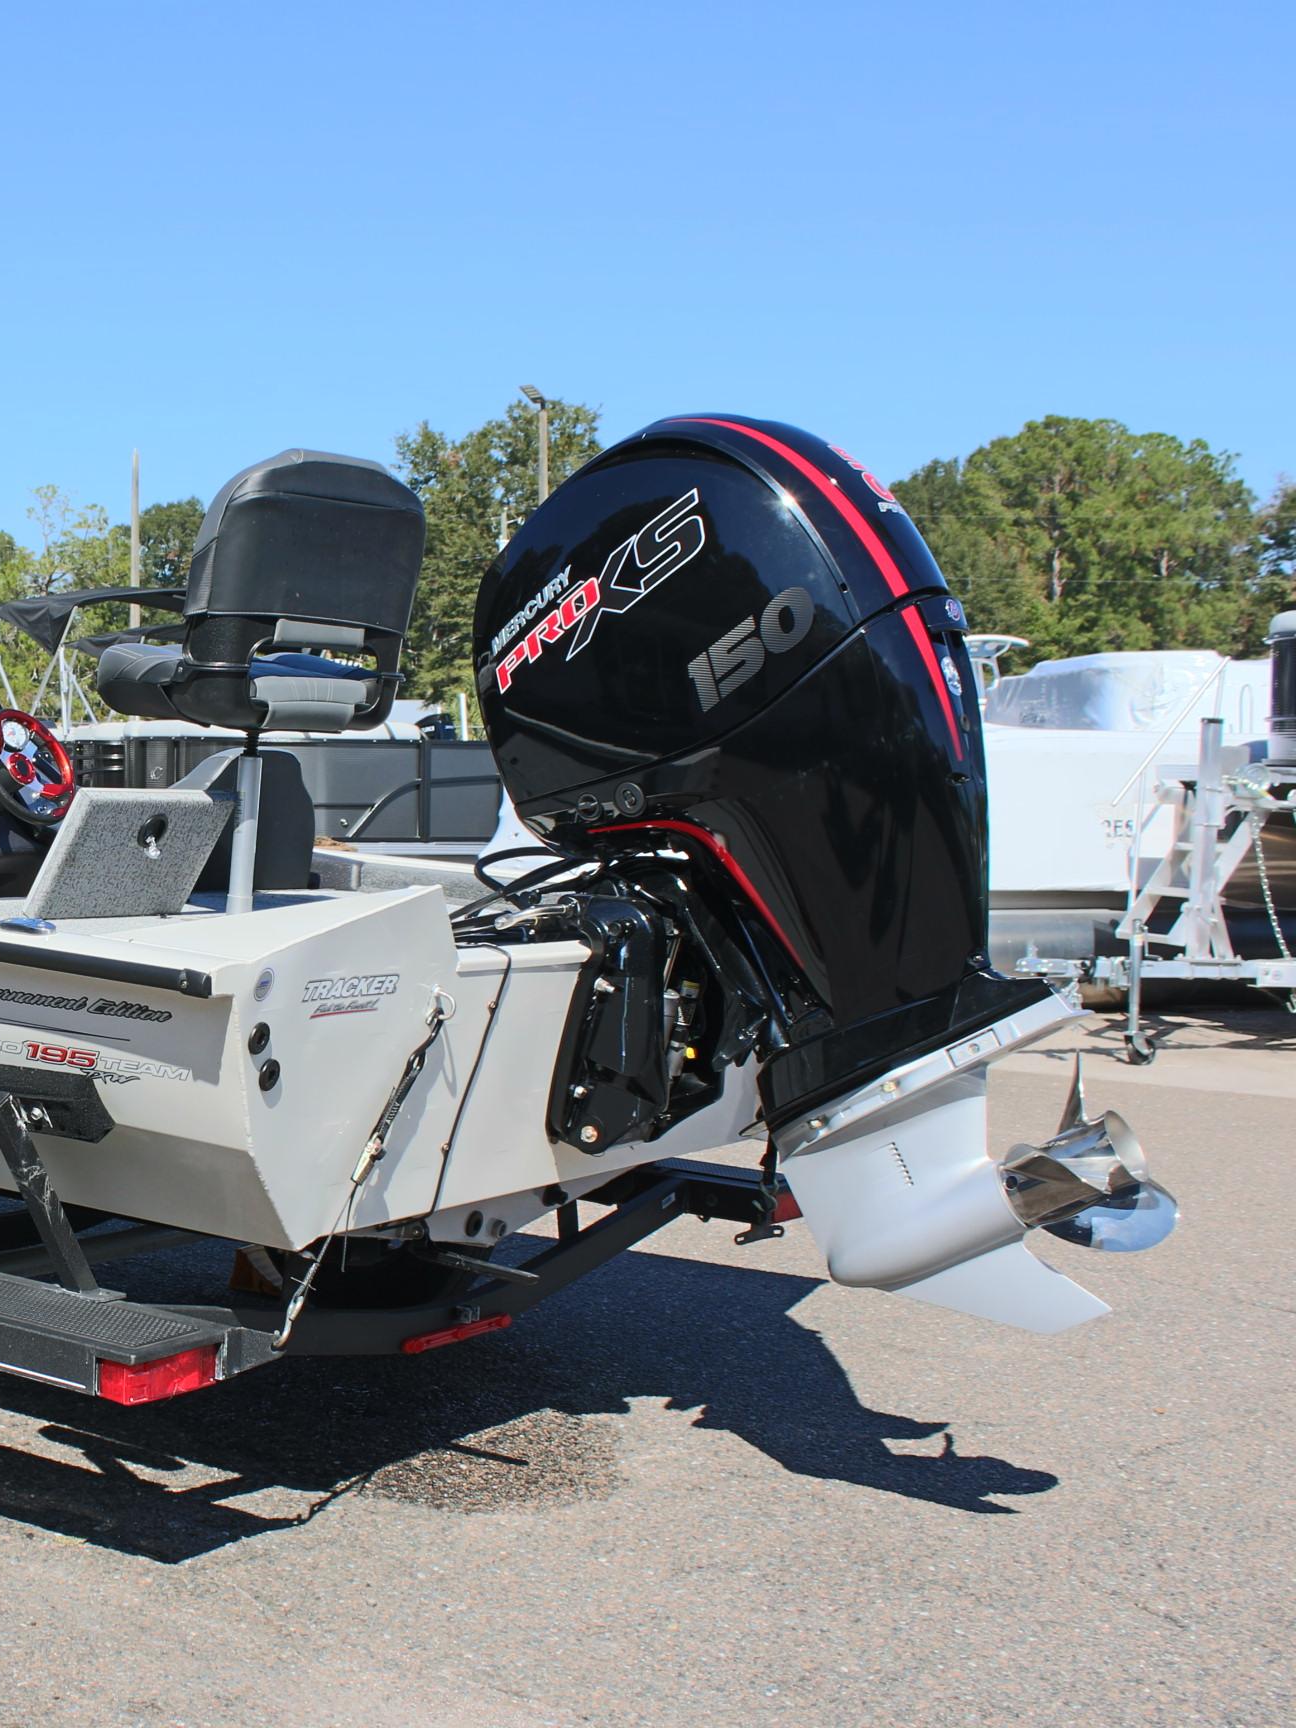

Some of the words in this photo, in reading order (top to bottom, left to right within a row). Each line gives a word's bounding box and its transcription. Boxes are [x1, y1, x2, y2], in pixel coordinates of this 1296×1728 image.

[491, 564, 572, 657] MERCURY
[687, 586, 815, 713] 150
[302, 974, 400, 1003] TRACKER
[88, 998, 173, 1023] Edition
[23, 1039, 101, 1071] 195
[99, 1055, 194, 1082] TEAM
